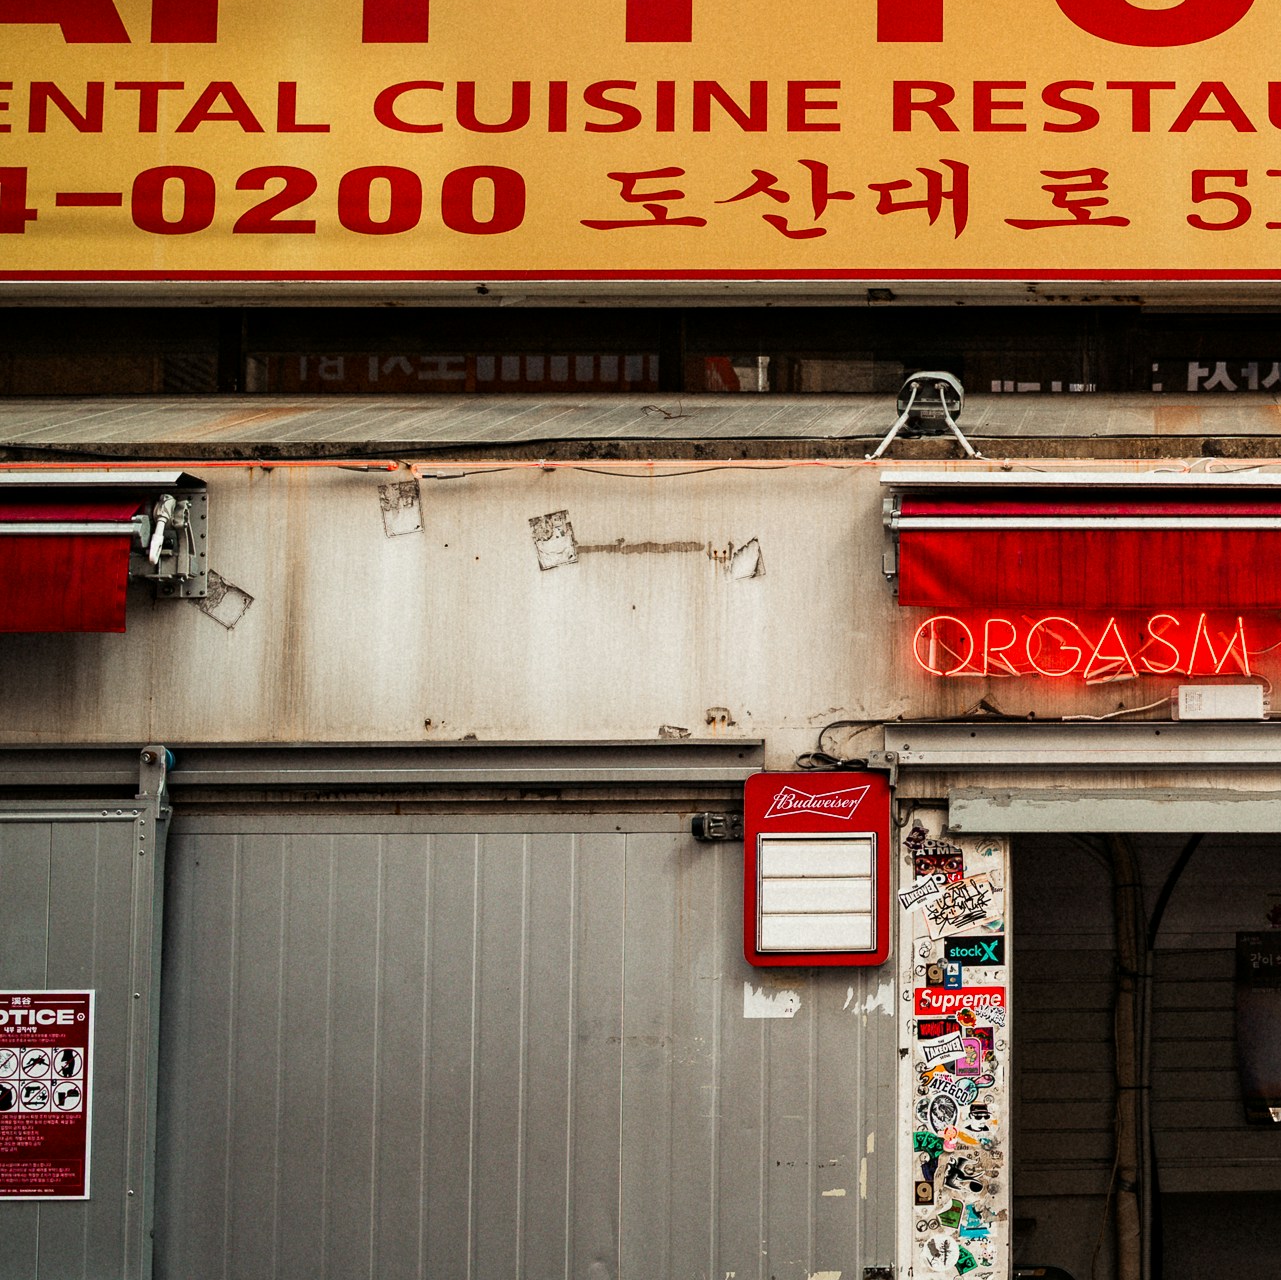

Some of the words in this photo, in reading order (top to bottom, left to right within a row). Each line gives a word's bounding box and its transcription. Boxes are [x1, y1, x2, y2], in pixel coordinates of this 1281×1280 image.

[0, 80, 331, 133] NTAL
[373, 80, 841, 133] CUISINE
[911, 613, 1251, 680] ORGASM
[773, 793, 859, 810] Budweiser
[950, 940, 999, 963] stockX
[920, 989, 1003, 1013] Supreme
[924, 1038, 963, 1060] TAKEOVER
